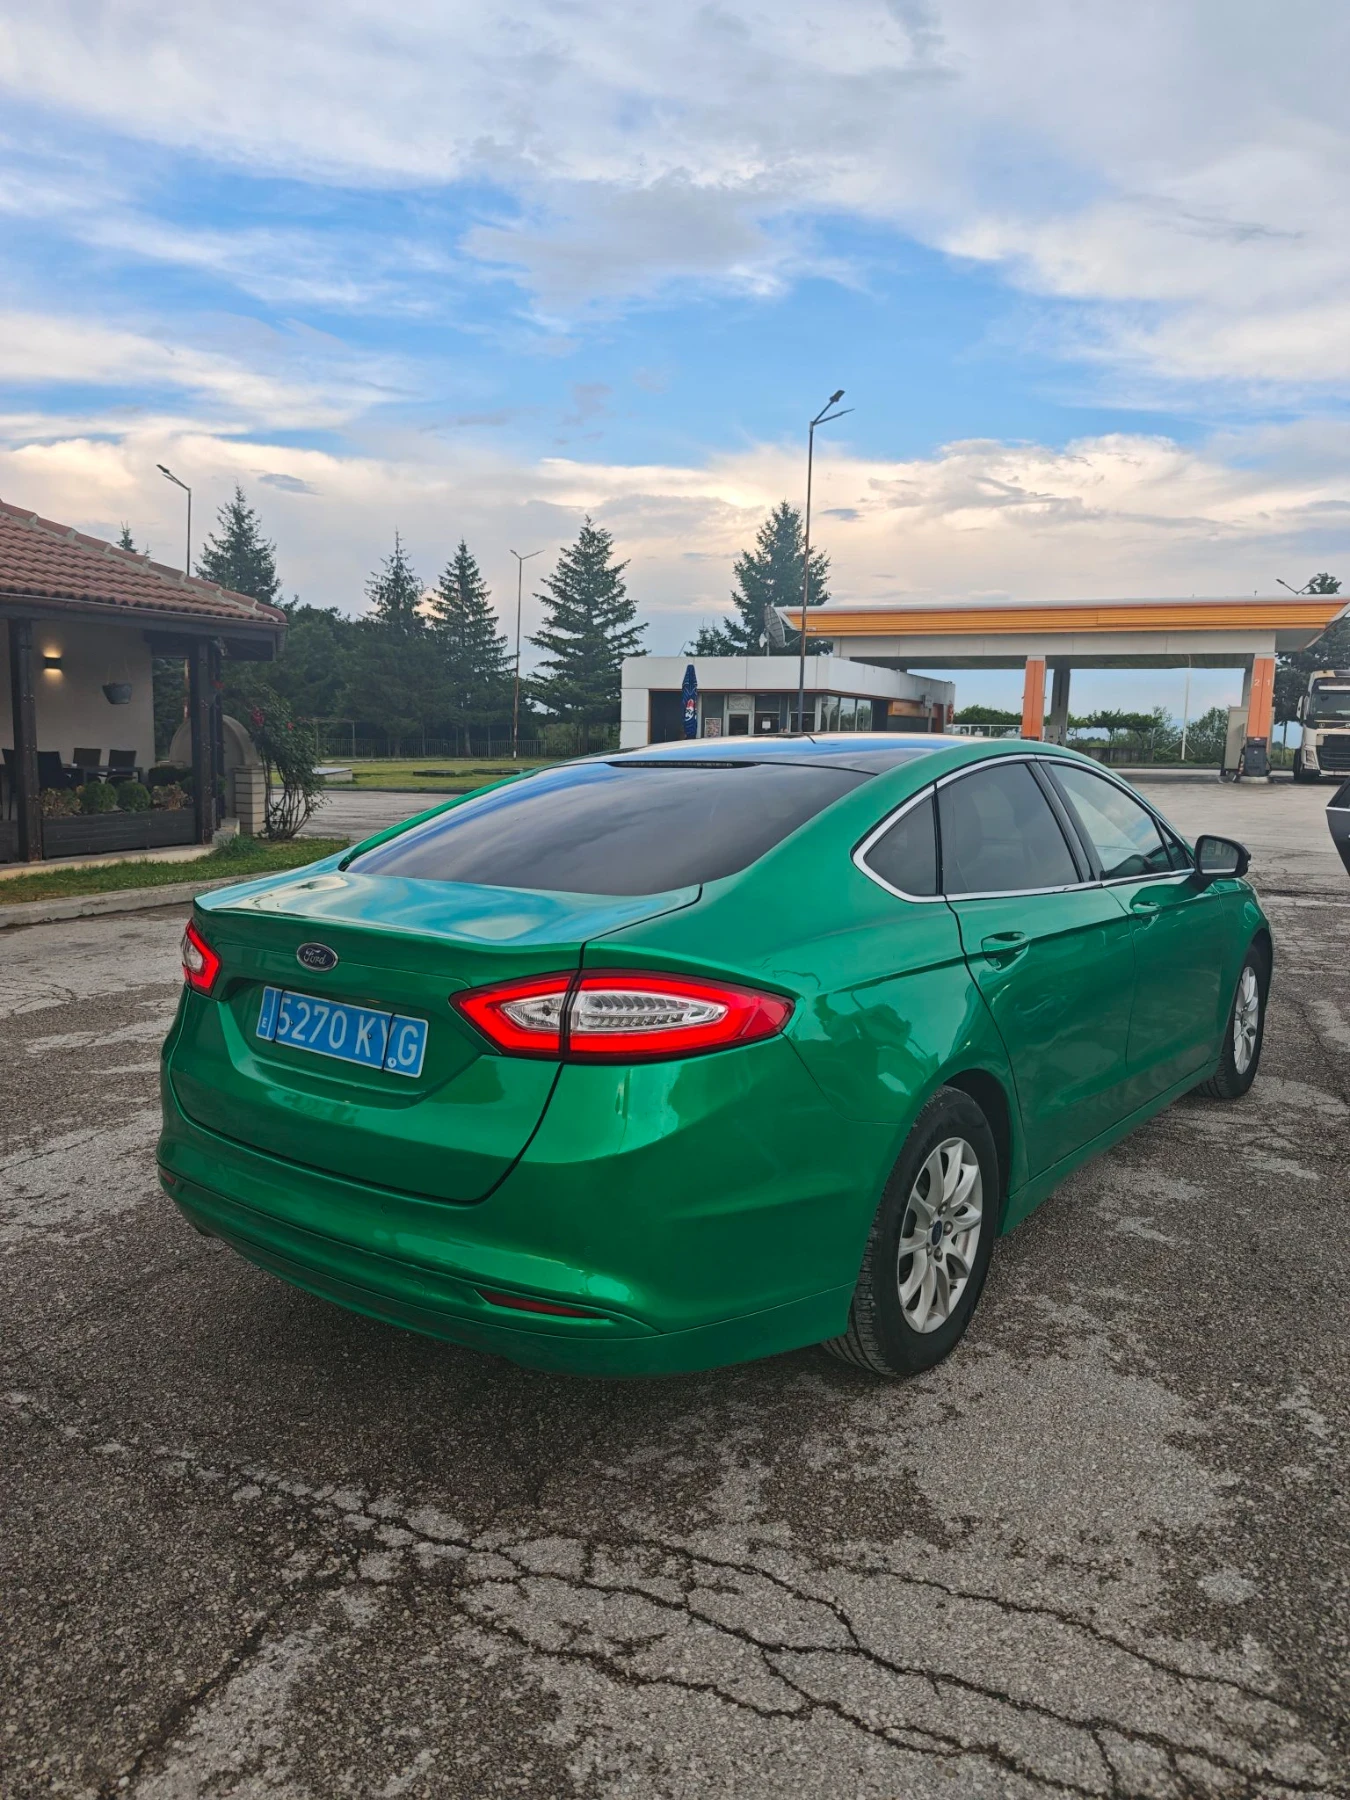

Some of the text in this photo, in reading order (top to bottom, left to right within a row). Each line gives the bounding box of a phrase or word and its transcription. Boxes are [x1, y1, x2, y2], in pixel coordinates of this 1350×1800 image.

[303, 947, 327, 965] Ford
[261, 1017, 268, 1028] E
[276, 997, 348, 1049] 5270
